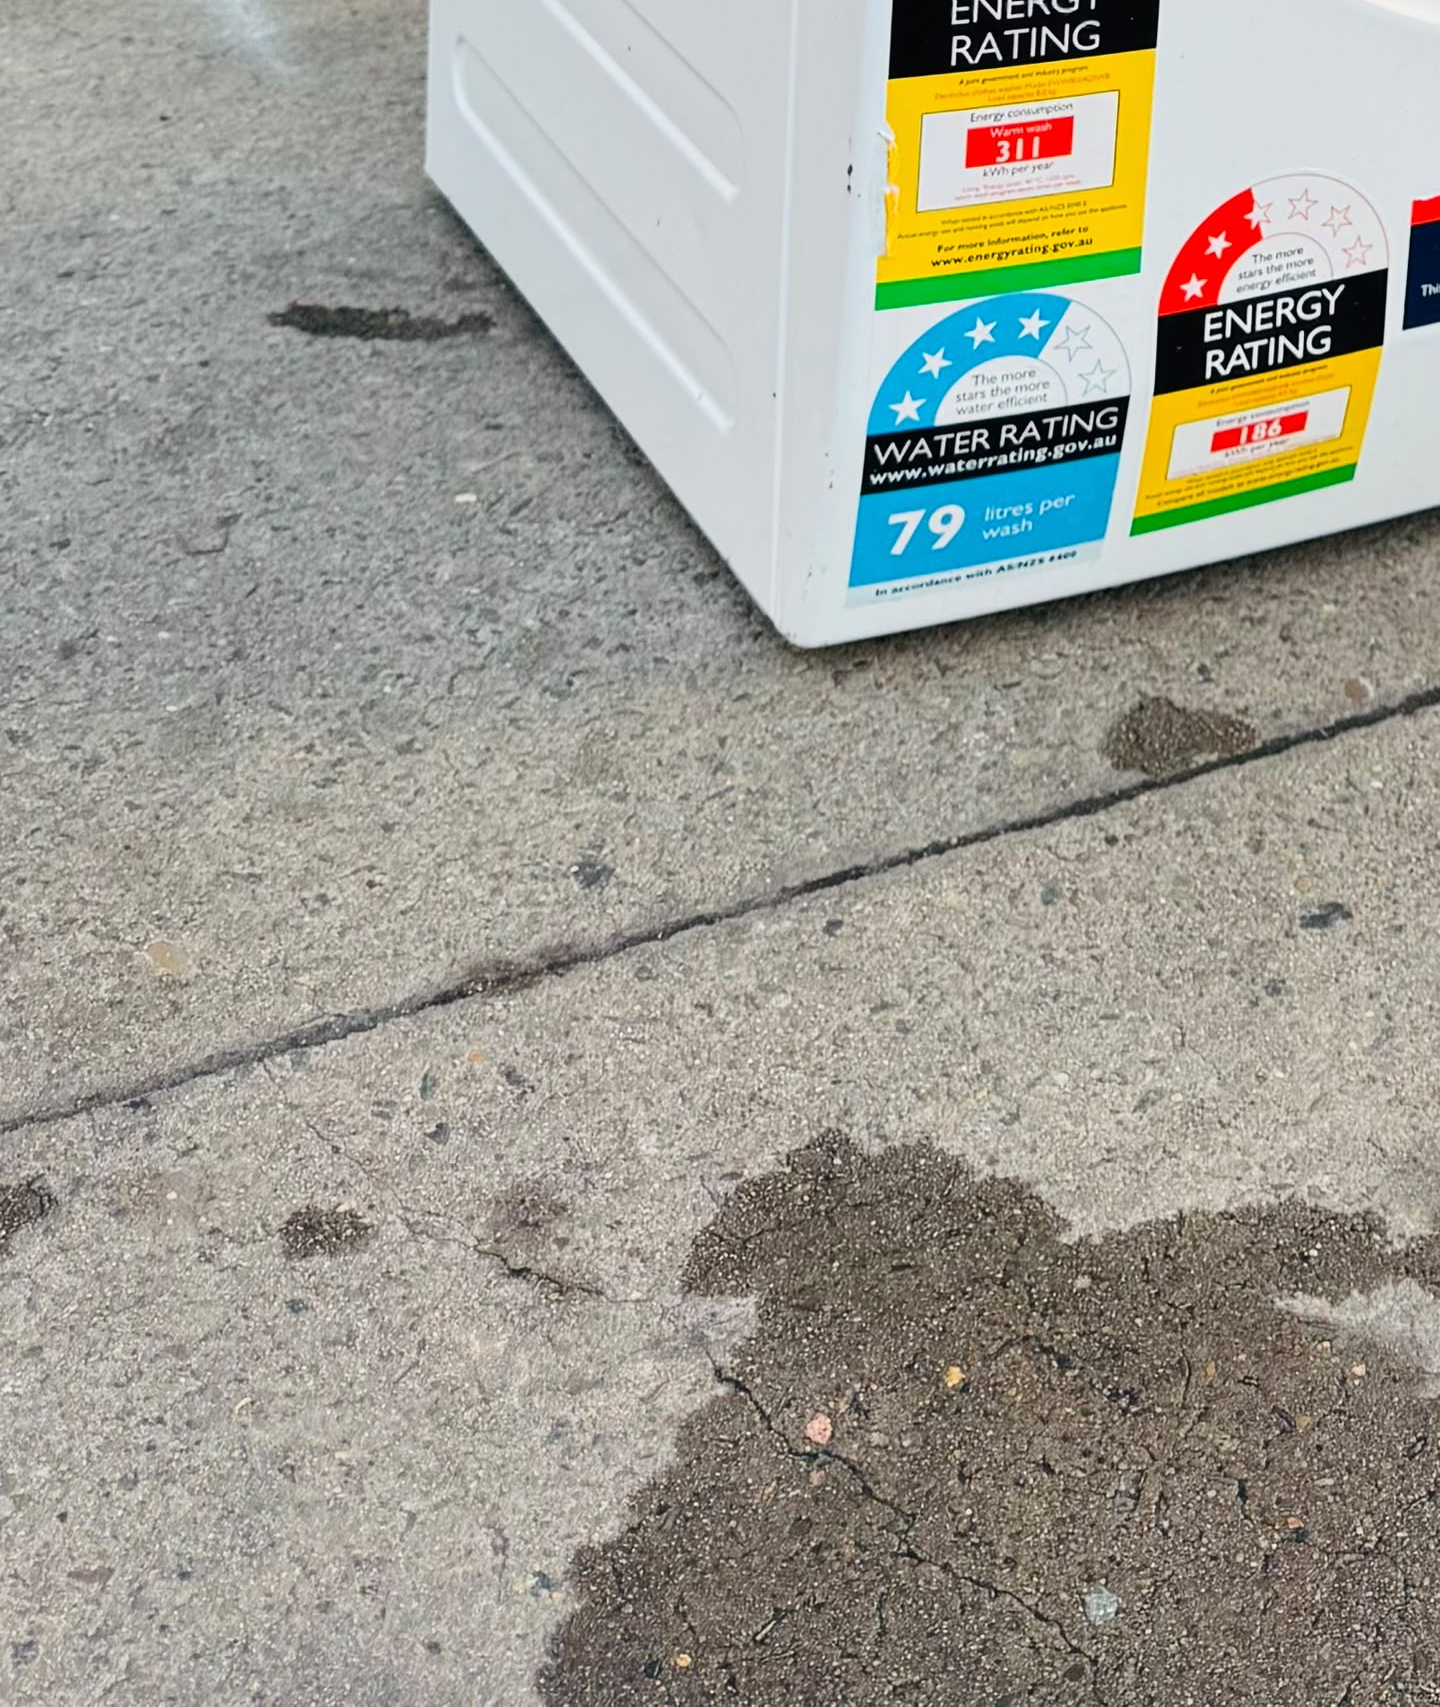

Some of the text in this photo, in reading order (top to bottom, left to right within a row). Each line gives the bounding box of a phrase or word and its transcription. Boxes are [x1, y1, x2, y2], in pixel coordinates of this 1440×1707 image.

[950, 20, 1101, 67] RATING
[970, 102, 1073, 123] Energy consumption
[990, 122, 1052, 138] Warm wash
[995, 136, 1040, 163] 311
[983, 161, 1054, 178] kWh per year
[931, 237, 1093, 267] www.energyrating.gov.au
[937, 243, 955, 253] For
[958, 241, 985, 250] more
[987, 232, 1048, 247] information,
[1051, 227, 1076, 237] refer
[1252, 247, 1304, 263] The more
[1236, 269, 1316, 293] energy efficient
[1239, 258, 1314, 280] stars the more
[1204, 284, 1345, 343] ENERGY
[1205, 325, 1332, 380] RATING
[956, 379, 1050, 402] stars the more
[973, 368, 1036, 387] The more
[956, 393, 1047, 415] water efficient
[874, 406, 1118, 465] WATER RATING
[1240, 419, 1283, 445] 186
[870, 433, 1117, 485] www.waterrating.gov.au
[887, 494, 1075, 556] 79 litres per
[982, 520, 1033, 540] wash
[876, 588, 888, 596] In
[891, 575, 961, 593] accordance
[966, 569, 992, 579] with
